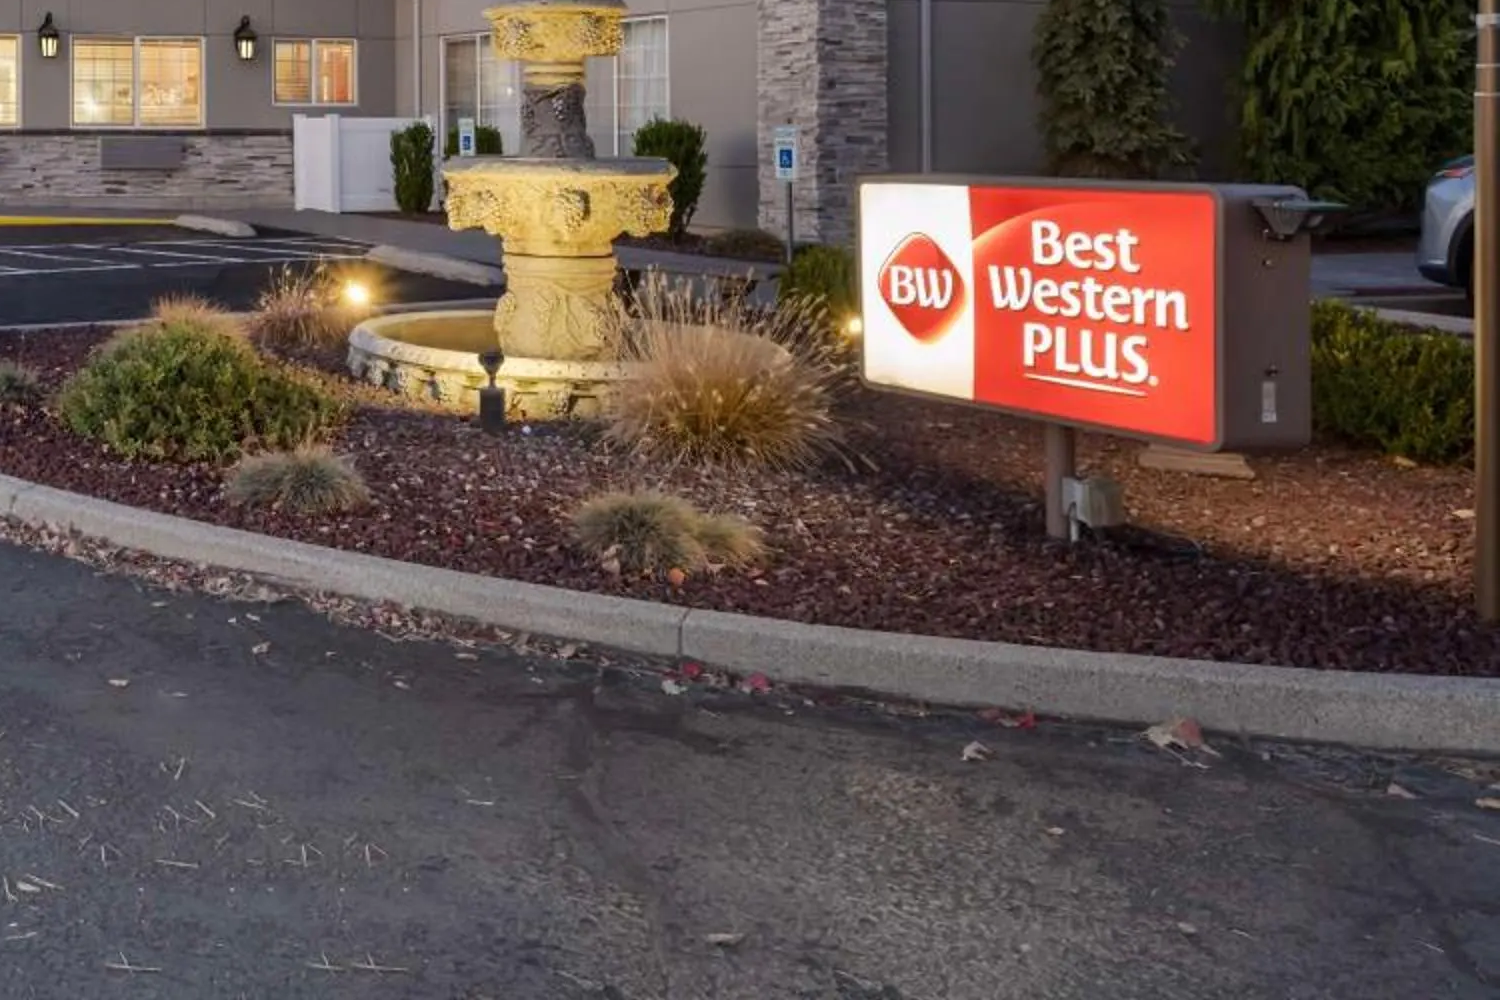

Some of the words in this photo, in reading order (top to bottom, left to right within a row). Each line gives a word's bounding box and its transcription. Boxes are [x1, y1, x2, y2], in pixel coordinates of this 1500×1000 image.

[1032, 219, 1141, 273] Best
[888, 265, 953, 309] BW
[988, 264, 1190, 330] Western
